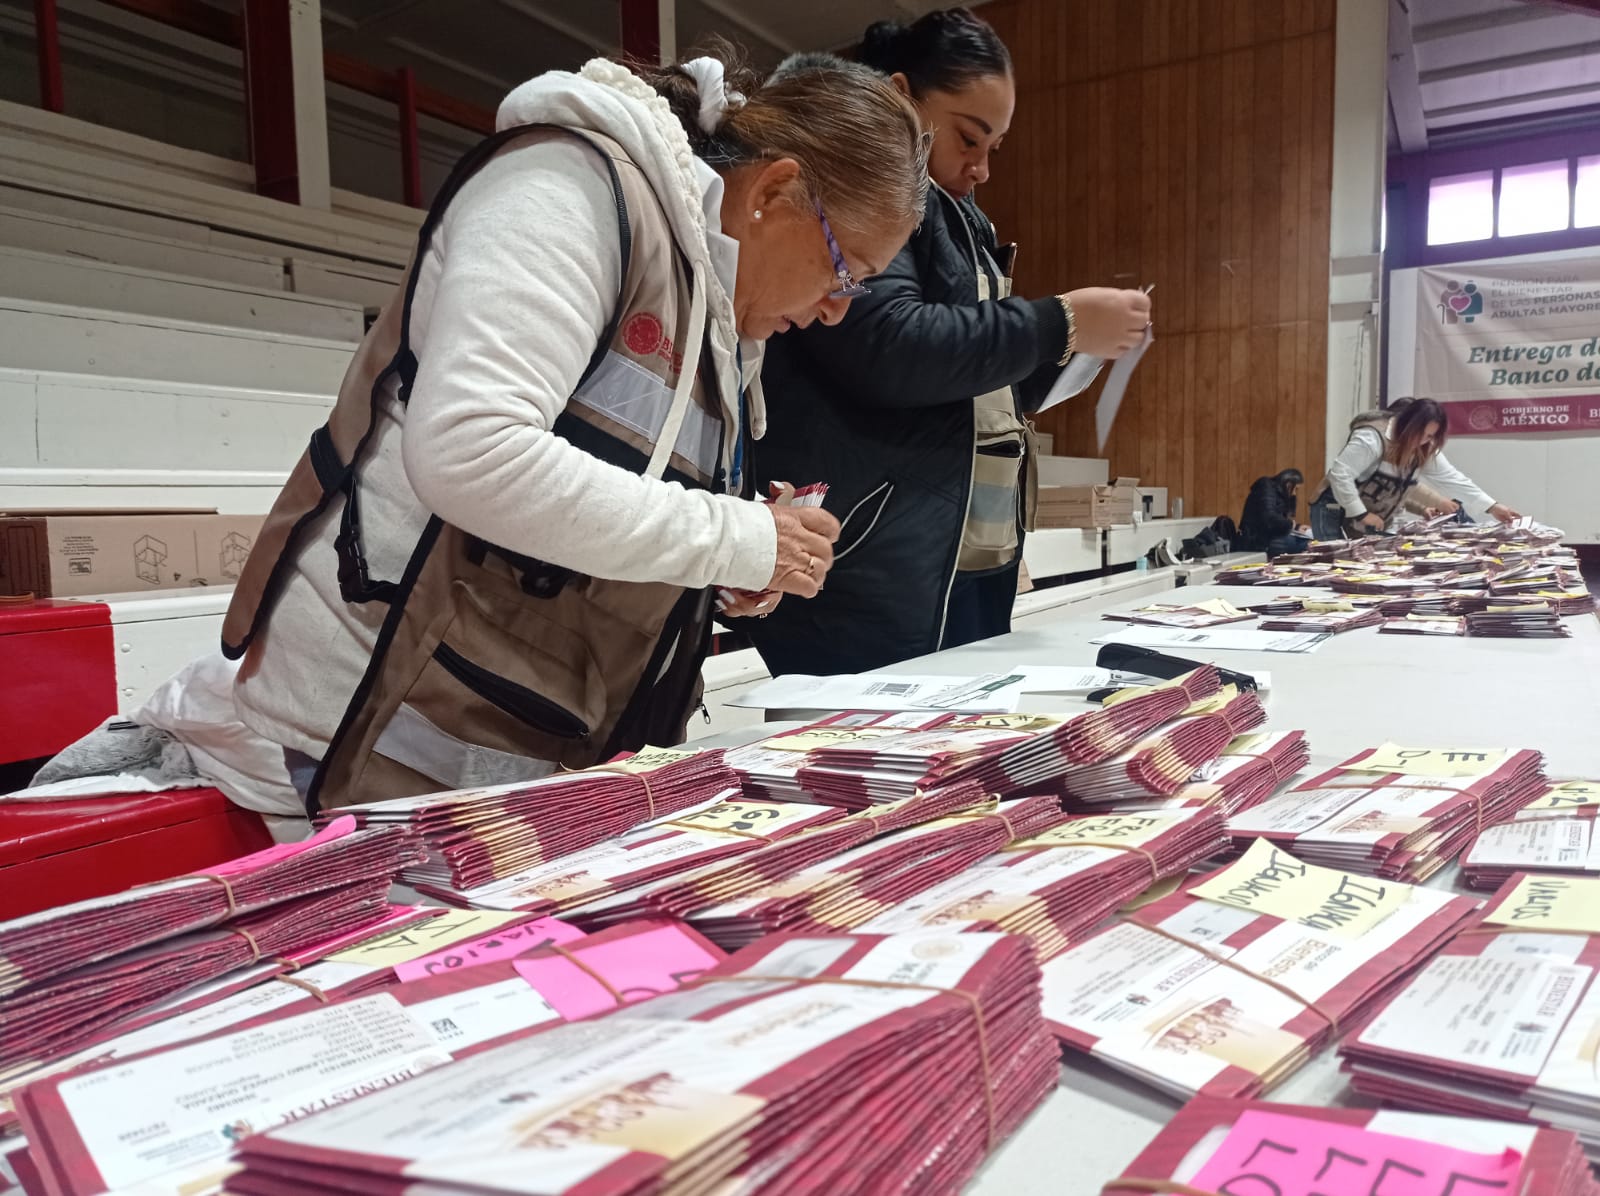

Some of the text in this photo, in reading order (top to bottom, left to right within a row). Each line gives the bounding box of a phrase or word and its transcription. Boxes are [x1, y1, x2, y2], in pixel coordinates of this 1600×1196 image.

[1491, 290, 1600, 308] DE LAS PERSONAS
[1508, 286, 1573, 297] BIENESTAR
[1491, 307, 1545, 319] ADULTAS
[1467, 336, 1600, 365] Entrega d
[1488, 368, 1569, 386] Banco
[1502, 405, 1570, 415] GOBIERNO DE
[1502, 414, 1570, 426] MÉXICO
[1262, 939, 1329, 979] Bienesta
